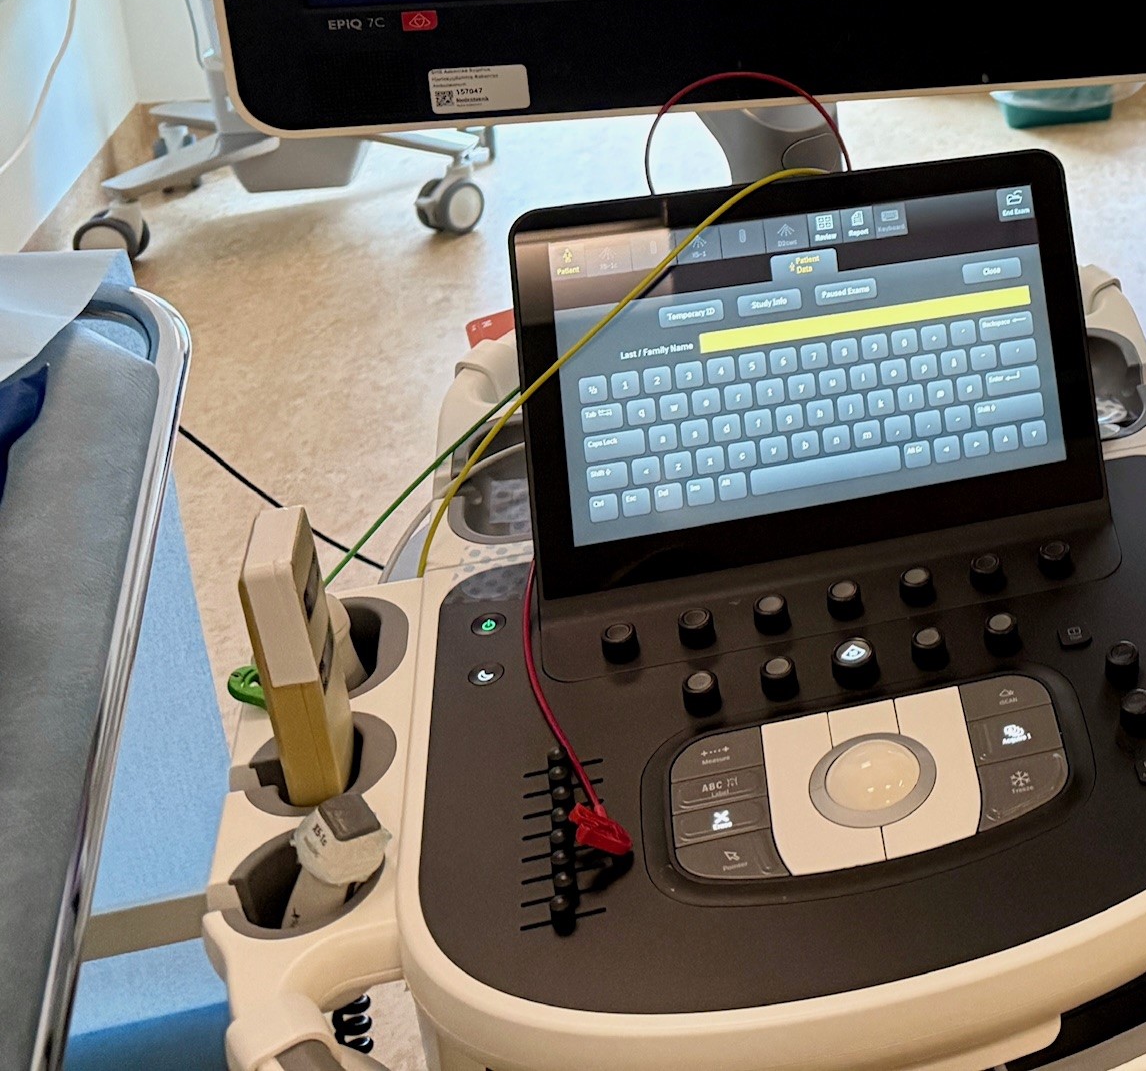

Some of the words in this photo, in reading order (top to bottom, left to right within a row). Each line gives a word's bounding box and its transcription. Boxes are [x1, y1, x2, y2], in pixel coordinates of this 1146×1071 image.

[328, 19, 362, 30] EPIQ
[367, 17, 385, 28] 7C
[1013, 207, 1031, 216] Exam
[815, 232, 837, 242] Review
[848, 228, 869, 238] Report
[796, 255, 820, 265] Patient
[557, 266, 580, 276] Patient
[797, 266, 813, 275] Data
[983, 266, 1001, 275] Close
[822, 288, 846, 299] Paused
[848, 285, 870, 296] Exams
[751, 298, 772, 310] Study
[773, 296, 787, 307] Info
[667, 309, 705, 322] Temporary
[705, 306, 715, 316] ID
[620, 349, 637, 360] Last
[643, 345, 669, 357] Family
[670, 342, 693, 353] Name
[584, 409, 597, 419] Tab
[588, 440, 602, 450] Caps
[603, 437, 618, 446] Lock
[988, 375, 1004, 384] Enter
[590, 469, 605, 478] Shift
[626, 494, 637, 503] Esc
[701, 755, 730, 765] Measure
[702, 781, 722, 792] ABC
[1012, 785, 1034, 794] Freeze
[711, 789, 729, 798] Label
[723, 861, 748, 871] Pointer
